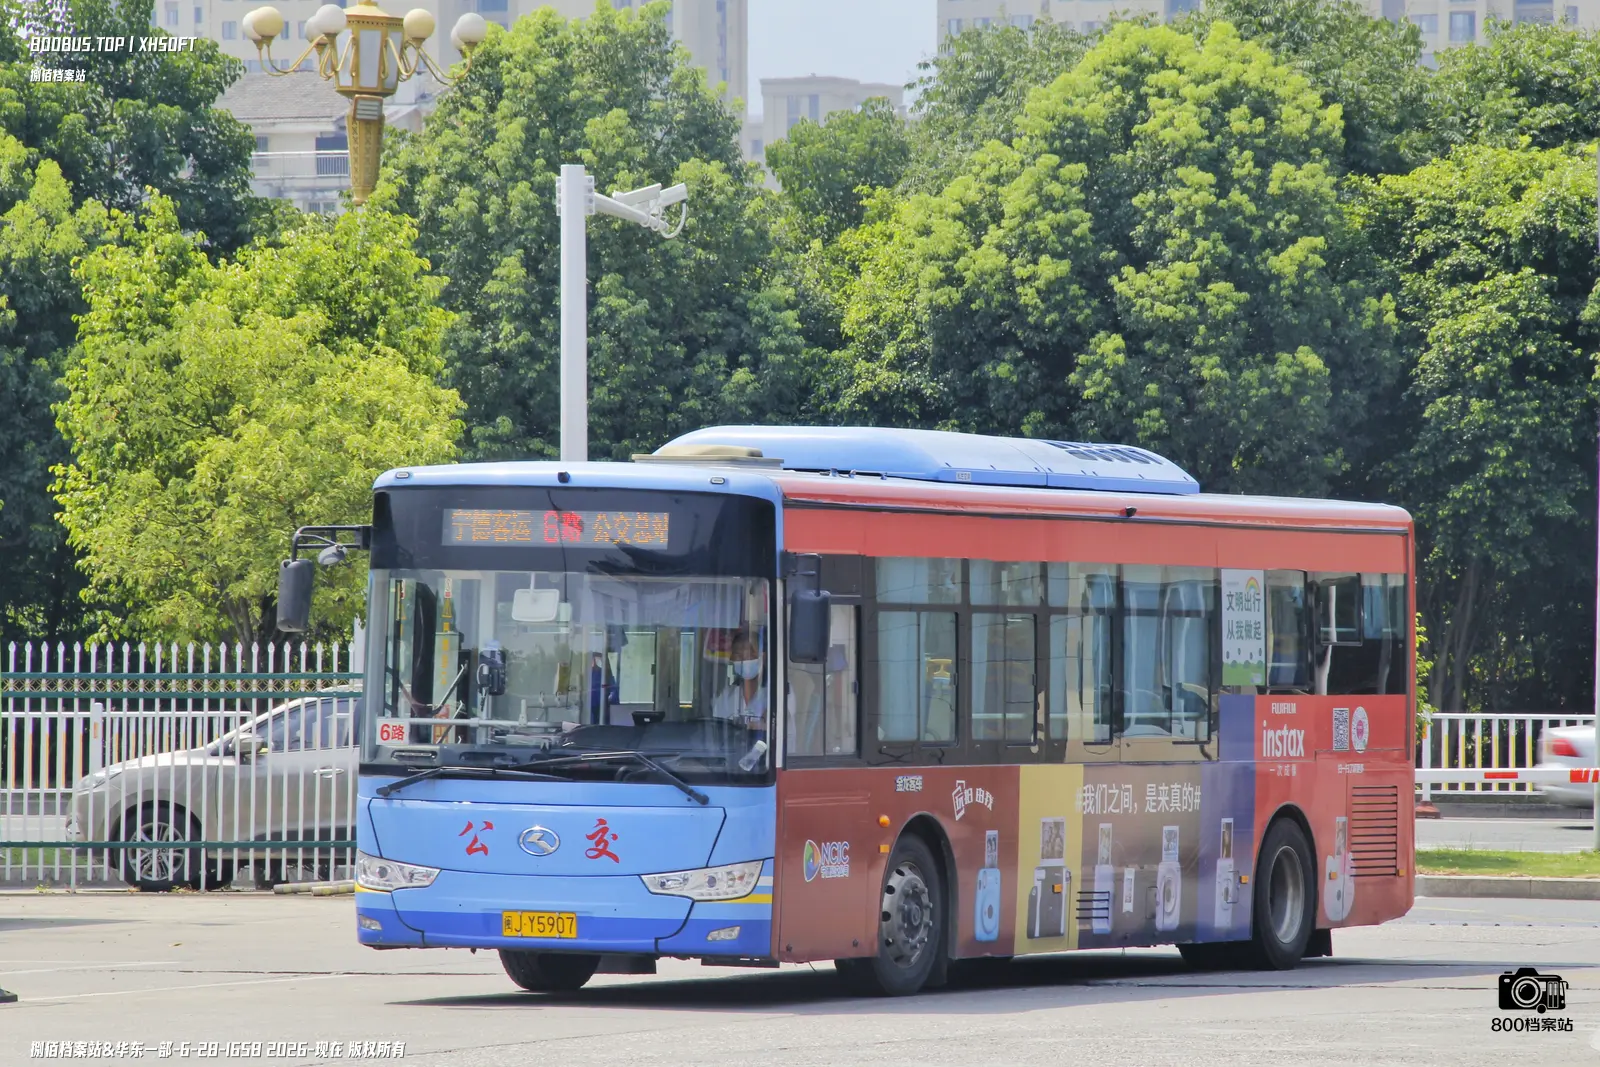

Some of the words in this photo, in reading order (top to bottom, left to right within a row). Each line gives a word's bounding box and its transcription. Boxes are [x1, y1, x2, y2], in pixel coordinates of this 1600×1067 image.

[1226, 591, 1262, 613] 文明出行
[1226, 620, 1262, 641] 从我做起
[1271, 702, 1297, 714] FUJIFILM
[380, 723, 405, 741] 6路
[1262, 719, 1305, 757] instax
[458, 820, 495, 856] 公
[584, 818, 621, 864] 交
[821, 841, 850, 865] NCIC
